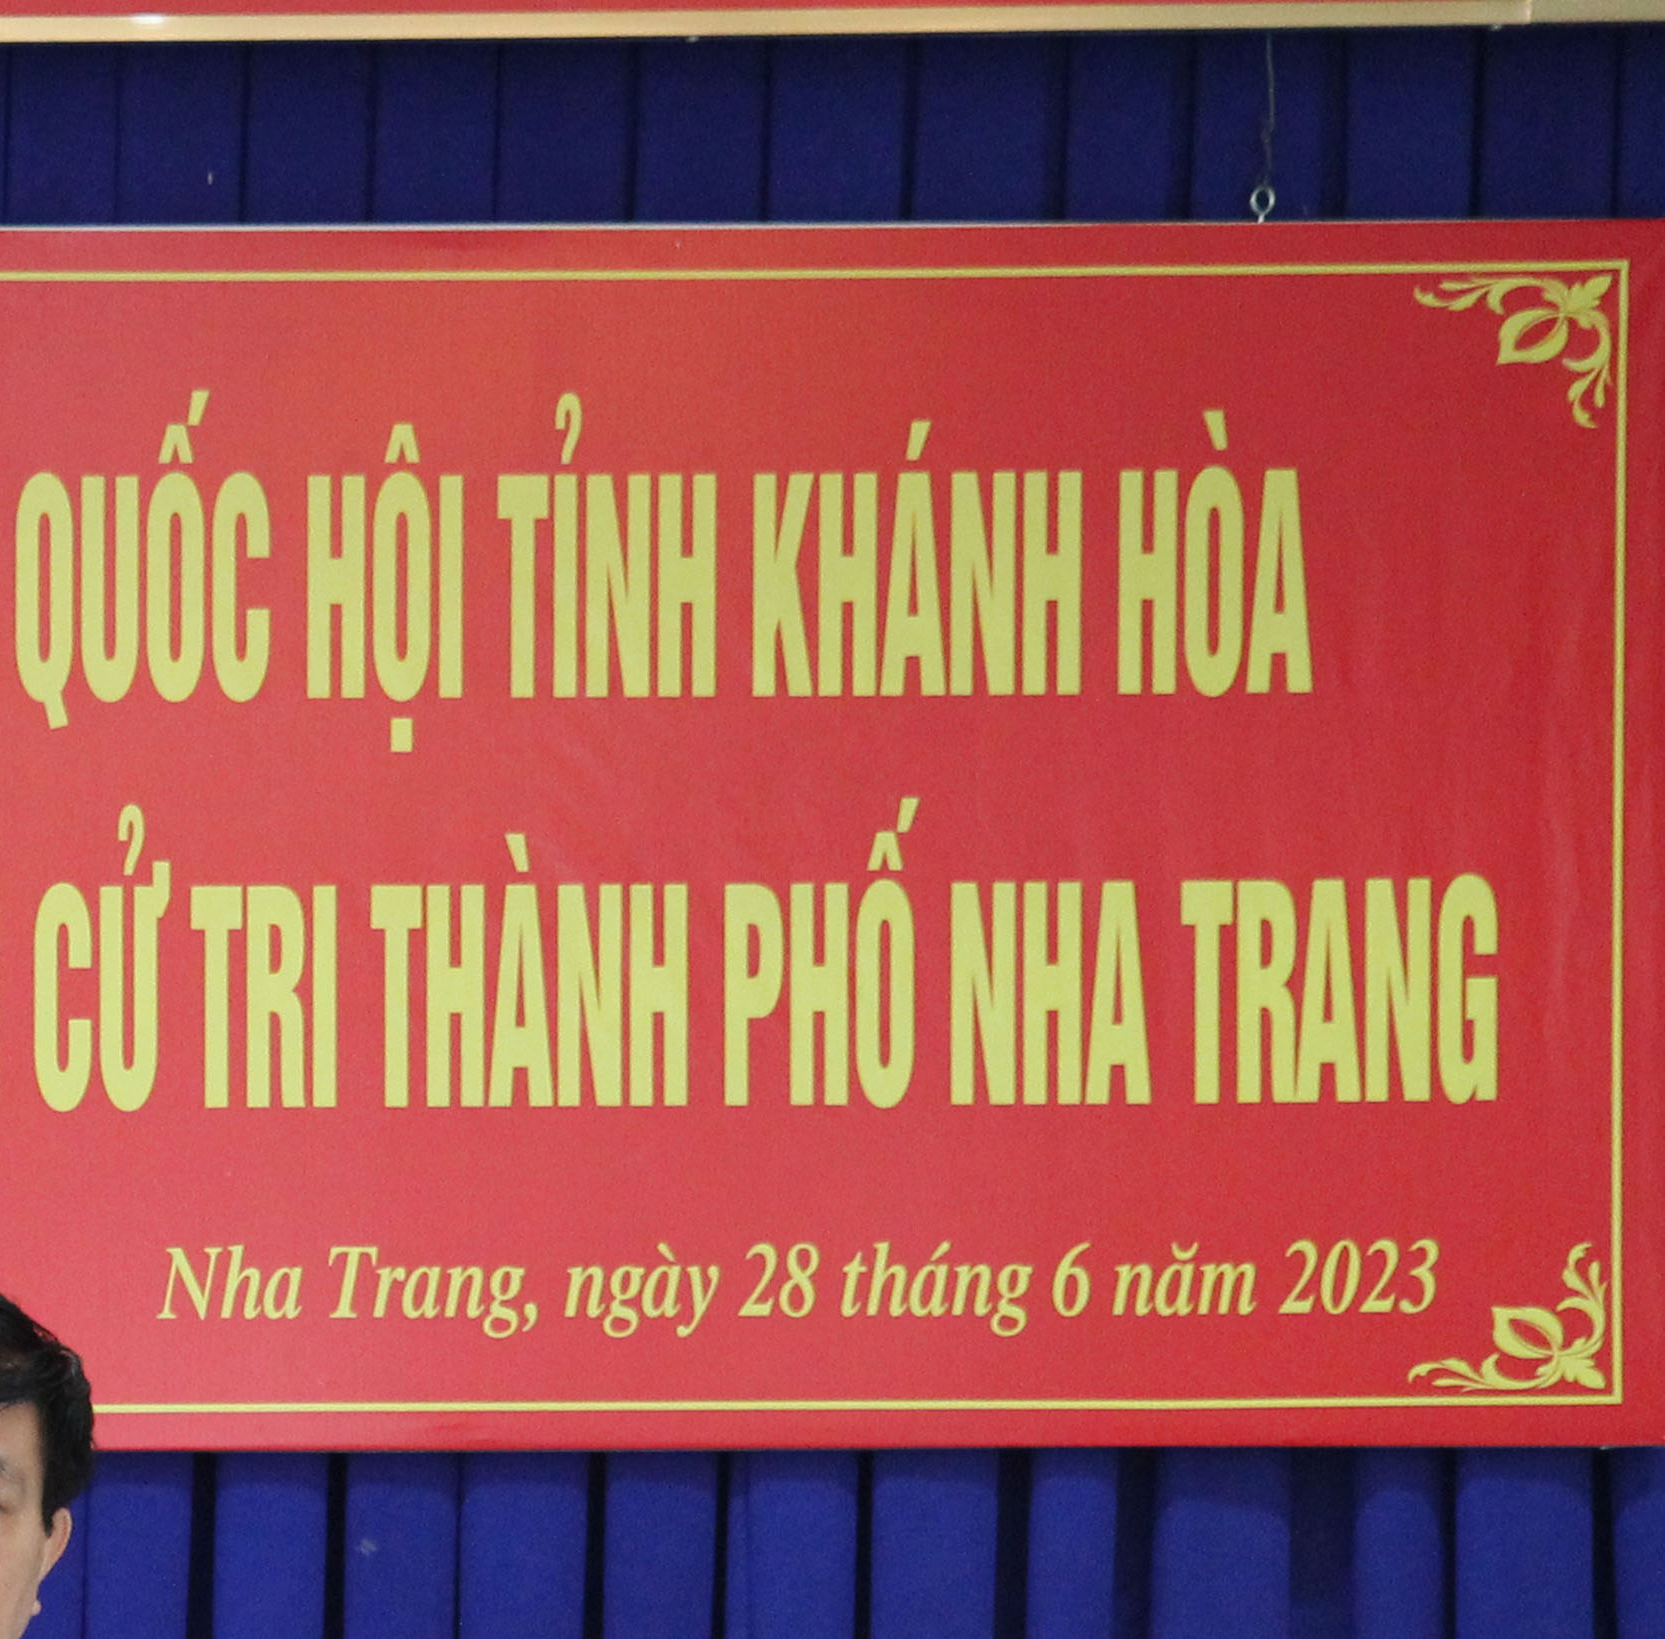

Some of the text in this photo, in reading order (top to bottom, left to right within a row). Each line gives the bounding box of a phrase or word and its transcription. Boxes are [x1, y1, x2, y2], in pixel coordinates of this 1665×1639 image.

[14, 388, 272, 731] QUỐC
[306, 421, 465, 753] HỘI
[496, 392, 718, 699] TỈNH
[752, 420, 1083, 703] KHÁNH
[1117, 410, 1313, 698] HÒA
[33, 802, 172, 1114] CỬ
[189, 883, 338, 1109] TRI
[369, 831, 689, 1108] THÀNH
[723, 796, 920, 1107] PHỐ
[950, 879, 1152, 1106] NHA
[1180, 873, 1498, 1105] TRANG
[155, 1238, 1439, 1339] Nha Trang, ngày 28 tháng 6 năm 2023
